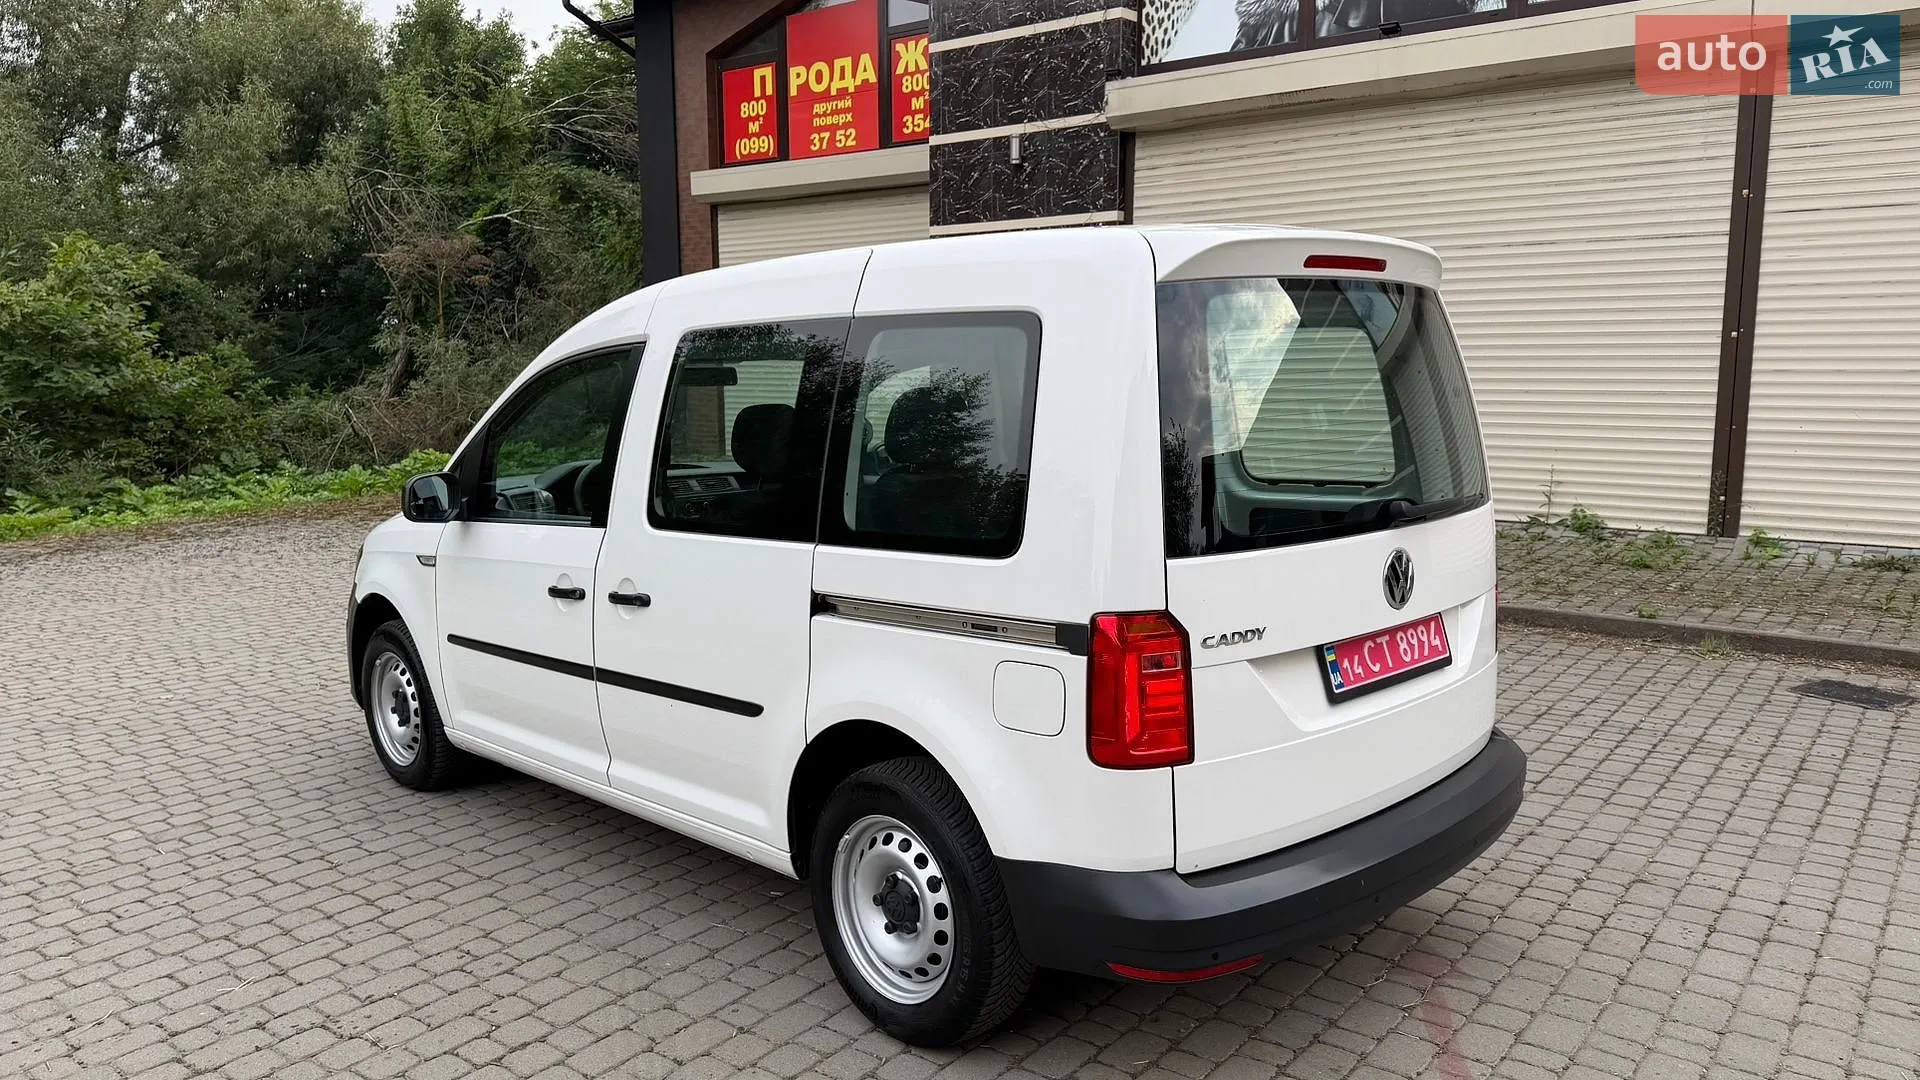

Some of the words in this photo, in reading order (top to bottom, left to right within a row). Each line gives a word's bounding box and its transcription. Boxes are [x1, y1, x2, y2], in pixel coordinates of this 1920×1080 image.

[753, 66, 773, 98] П
[789, 53, 878, 96] РОДА
[740, 99, 767, 118] 800
[812, 95, 852, 115] другий
[813, 112, 853, 127] поверх
[735, 134, 774, 160] (099)
[810, 131, 830, 151] 37
[835, 128, 857, 148] 52
[1200, 626, 1267, 649] CADDY
[1396, 621, 1442, 662] 8994
[1331, 672, 1344, 685] UA
